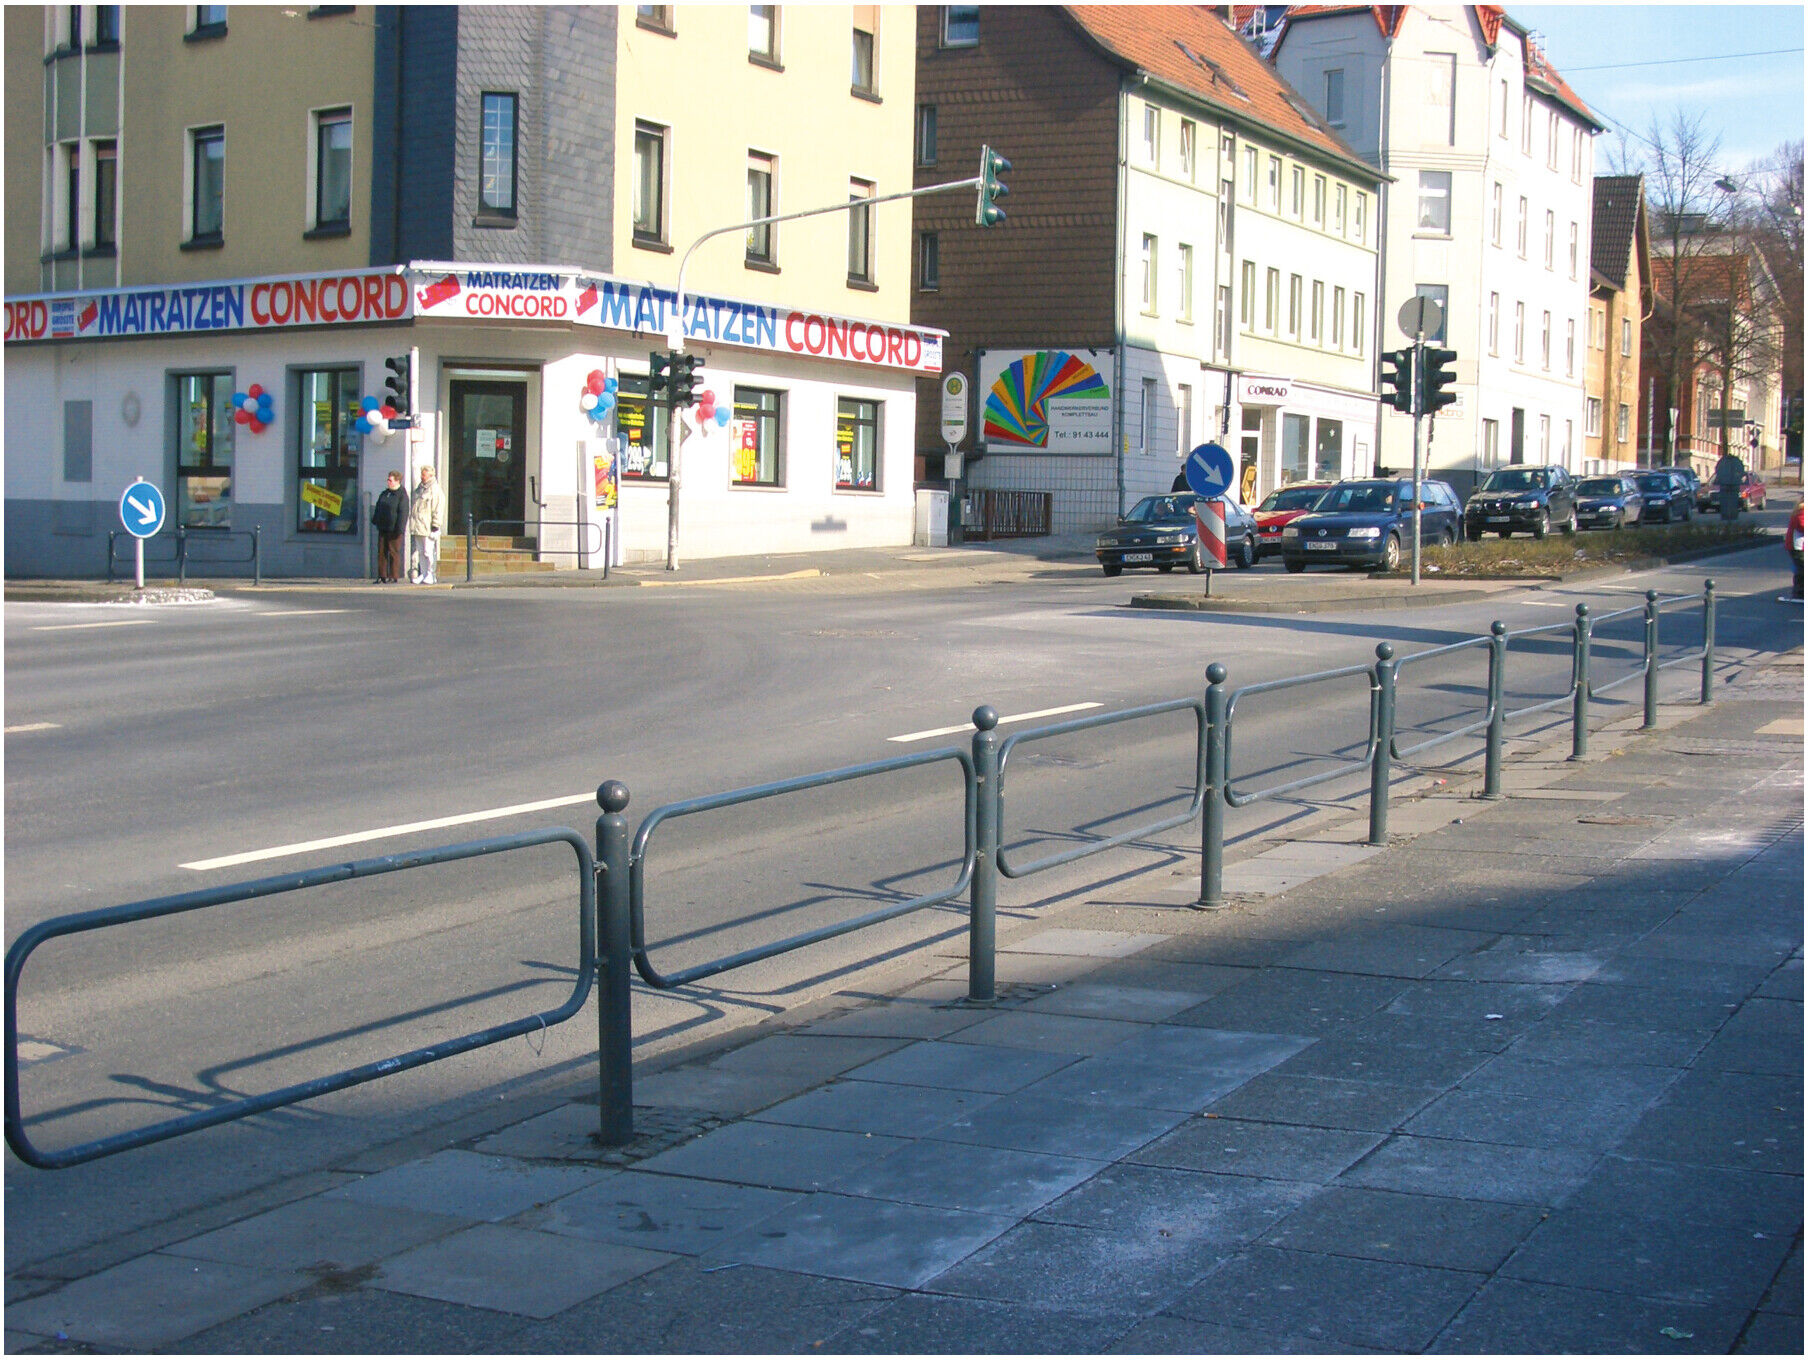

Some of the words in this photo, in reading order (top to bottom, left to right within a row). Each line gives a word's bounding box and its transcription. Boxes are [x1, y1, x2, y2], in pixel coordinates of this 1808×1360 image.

[466, 271, 559, 291] MATRATZEN
[99, 284, 244, 334] MATRATZEN
[251, 274, 408, 326] CONCORD
[465, 293, 568, 317] CONCORD
[785, 311, 921, 367] CONCORD
[1247, 385, 1288, 397] CONRAD
[1095, 431, 1109, 439] 444
